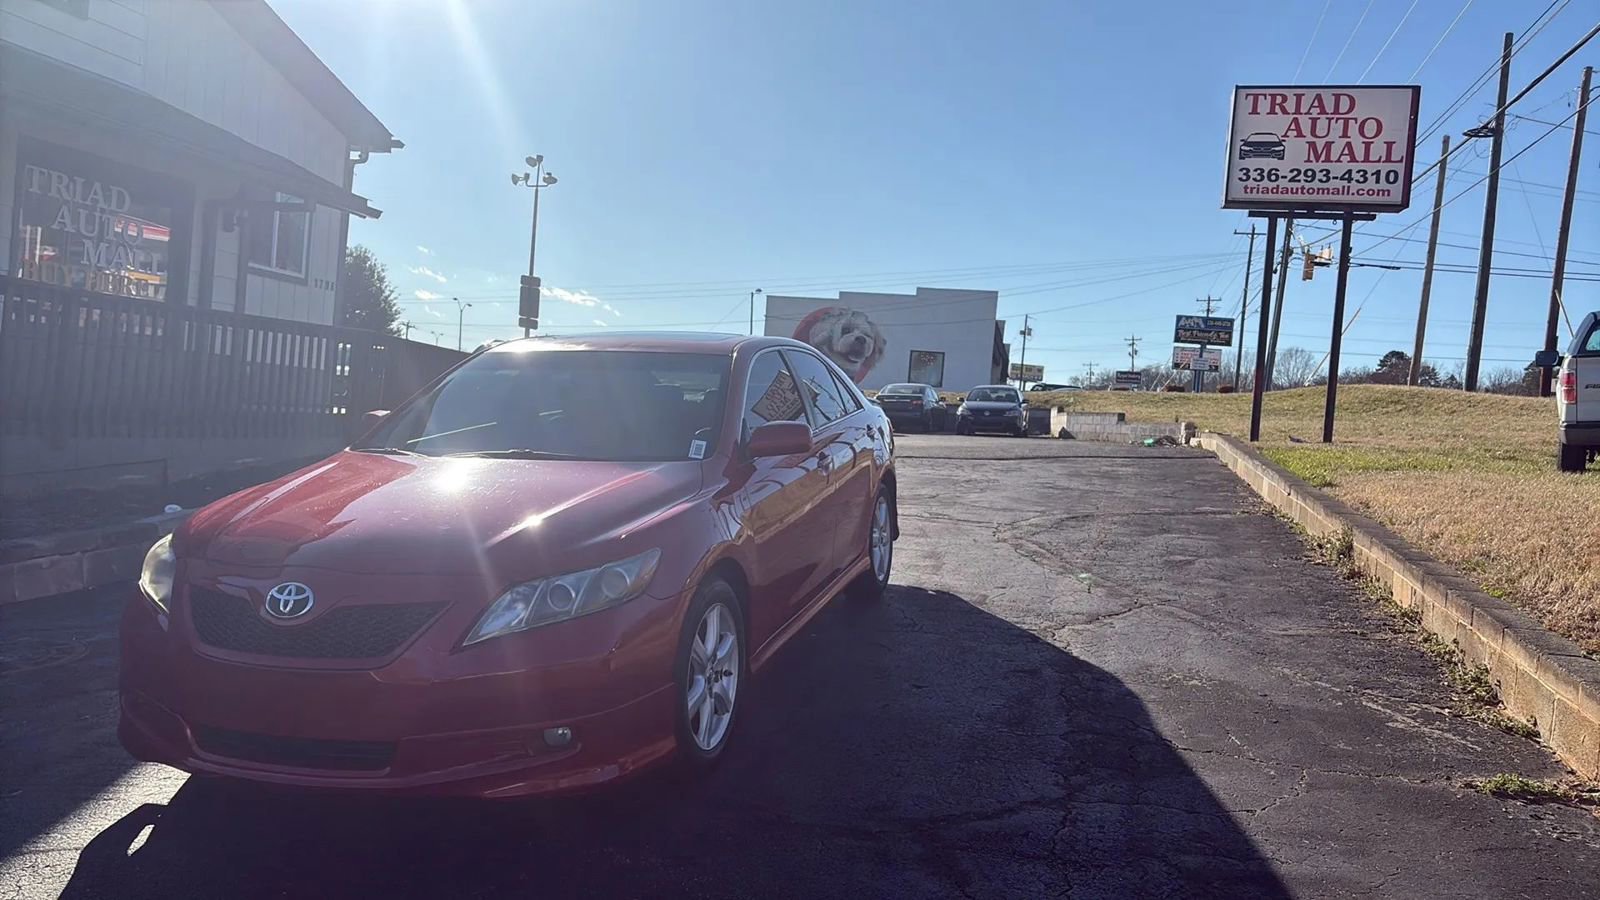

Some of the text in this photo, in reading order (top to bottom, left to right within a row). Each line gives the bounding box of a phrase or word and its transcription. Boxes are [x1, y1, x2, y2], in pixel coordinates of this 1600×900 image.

[1245, 93, 1356, 115] TRIAD
[1282, 117, 1383, 139] AUTO
[1304, 141, 1404, 163] MALL
[1238, 167, 1399, 185] 336-293-4310
[25, 164, 131, 213] TRIAD
[1243, 184, 1391, 197] triadautomall.com
[51, 205, 143, 245] AUTO
